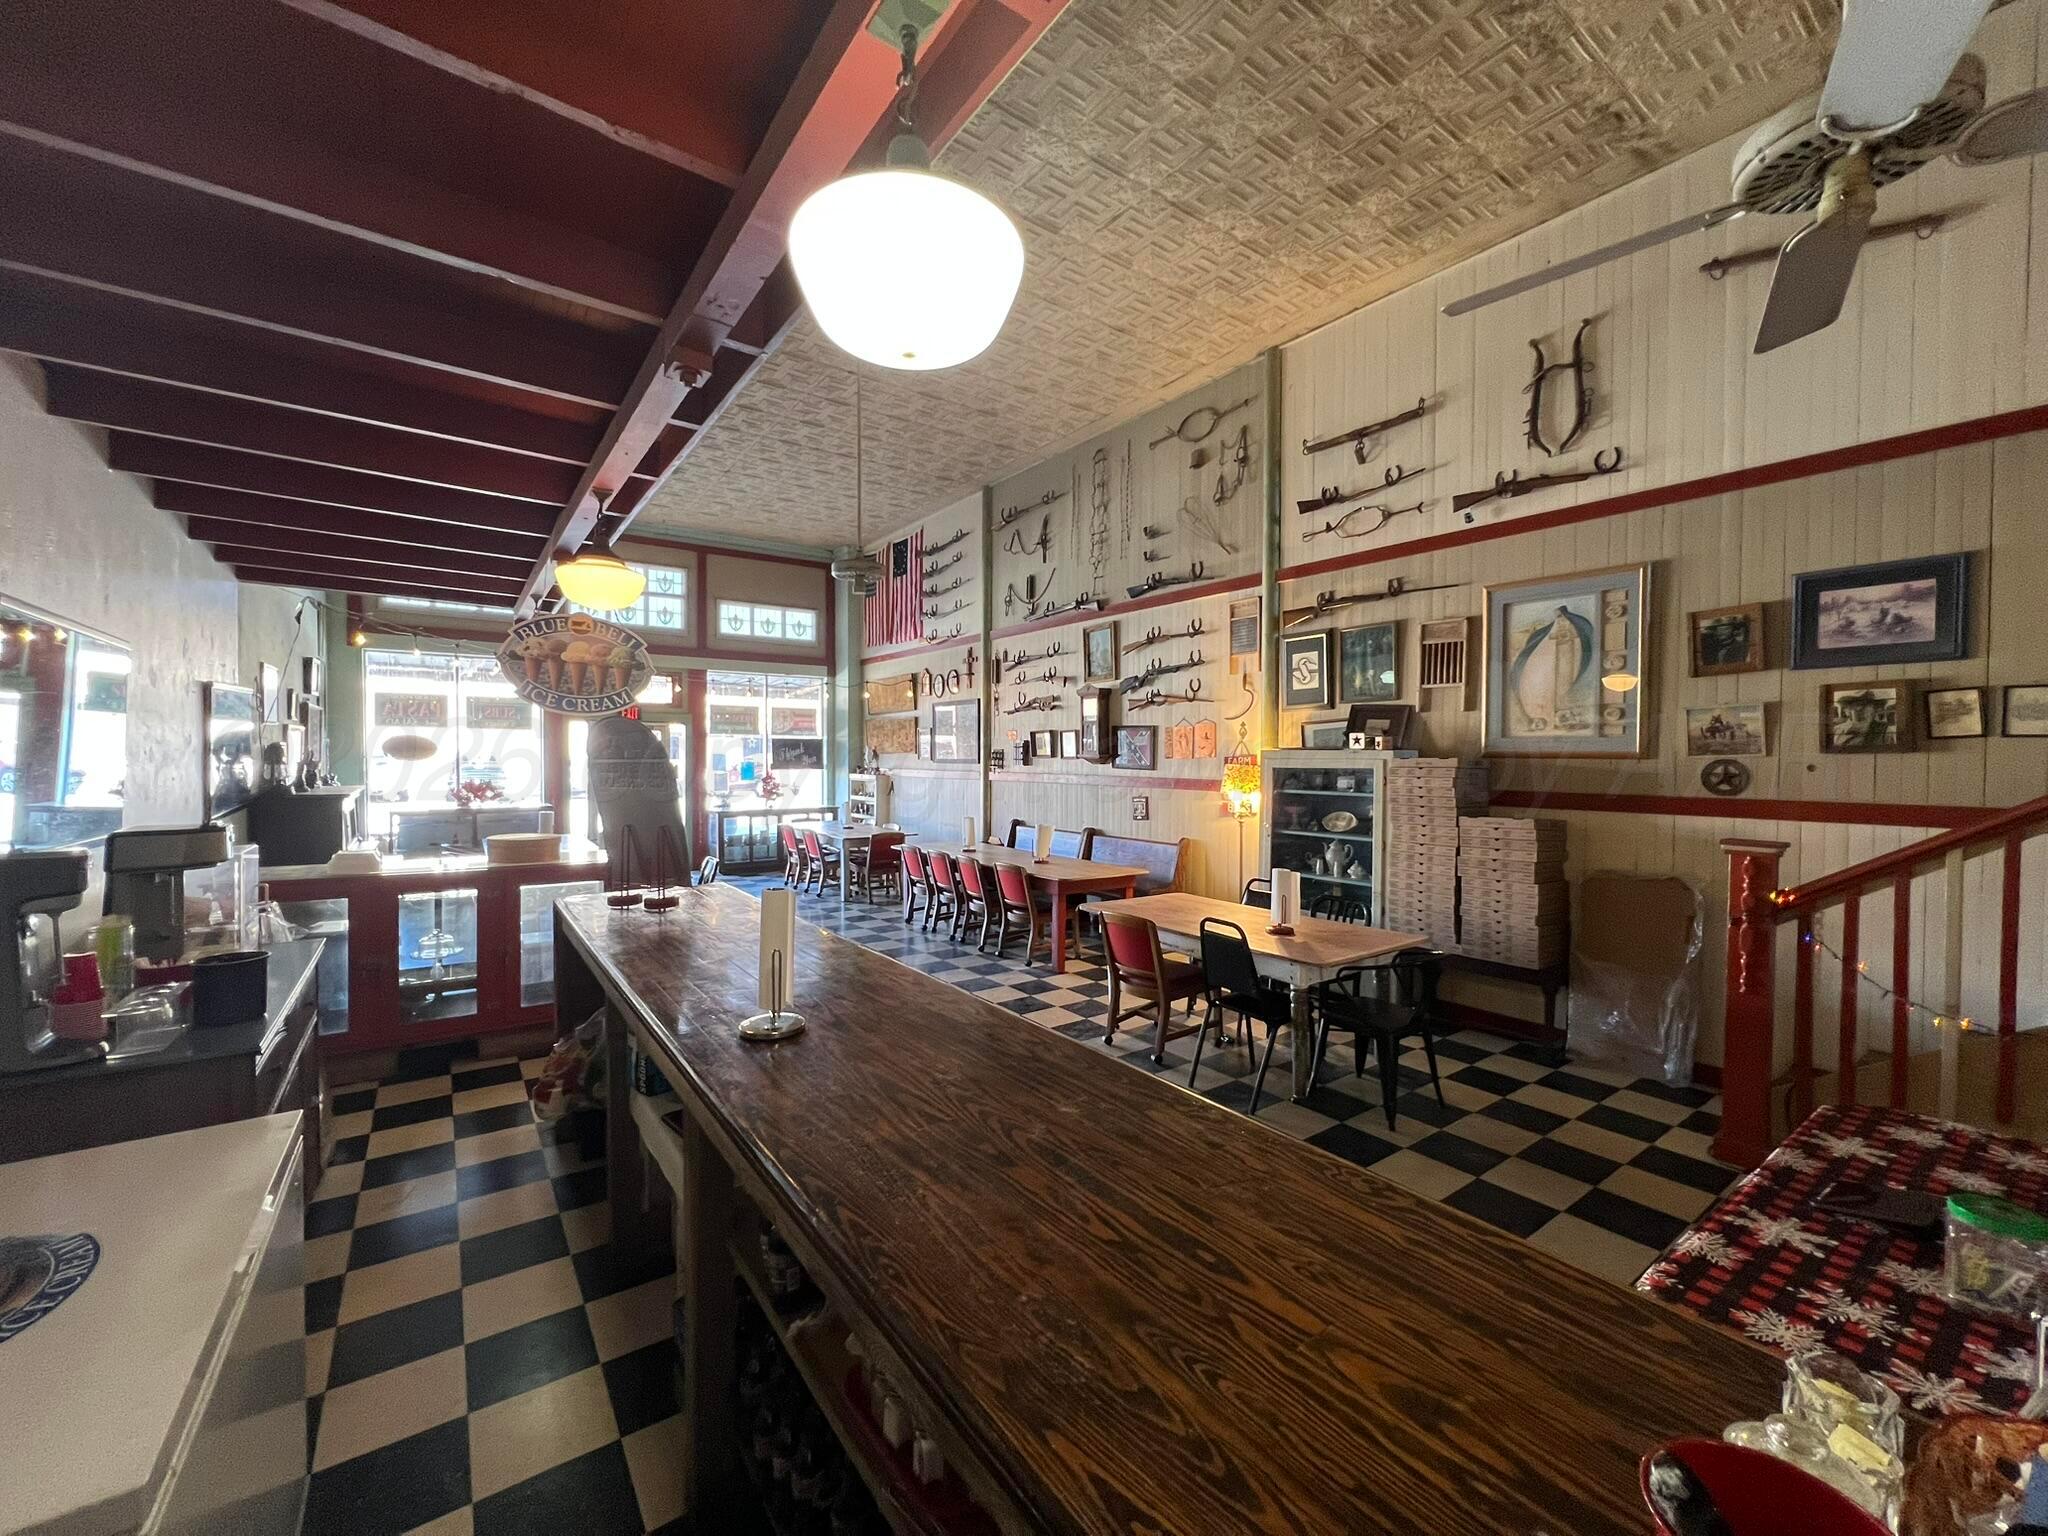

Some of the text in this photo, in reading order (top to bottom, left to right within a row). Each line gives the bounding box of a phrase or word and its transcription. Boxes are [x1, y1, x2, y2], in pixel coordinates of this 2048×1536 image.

[518, 619, 637, 648] BLUE BELL
[523, 684, 630, 712] ICE CREAM
[1228, 756, 1250, 765] FARM
